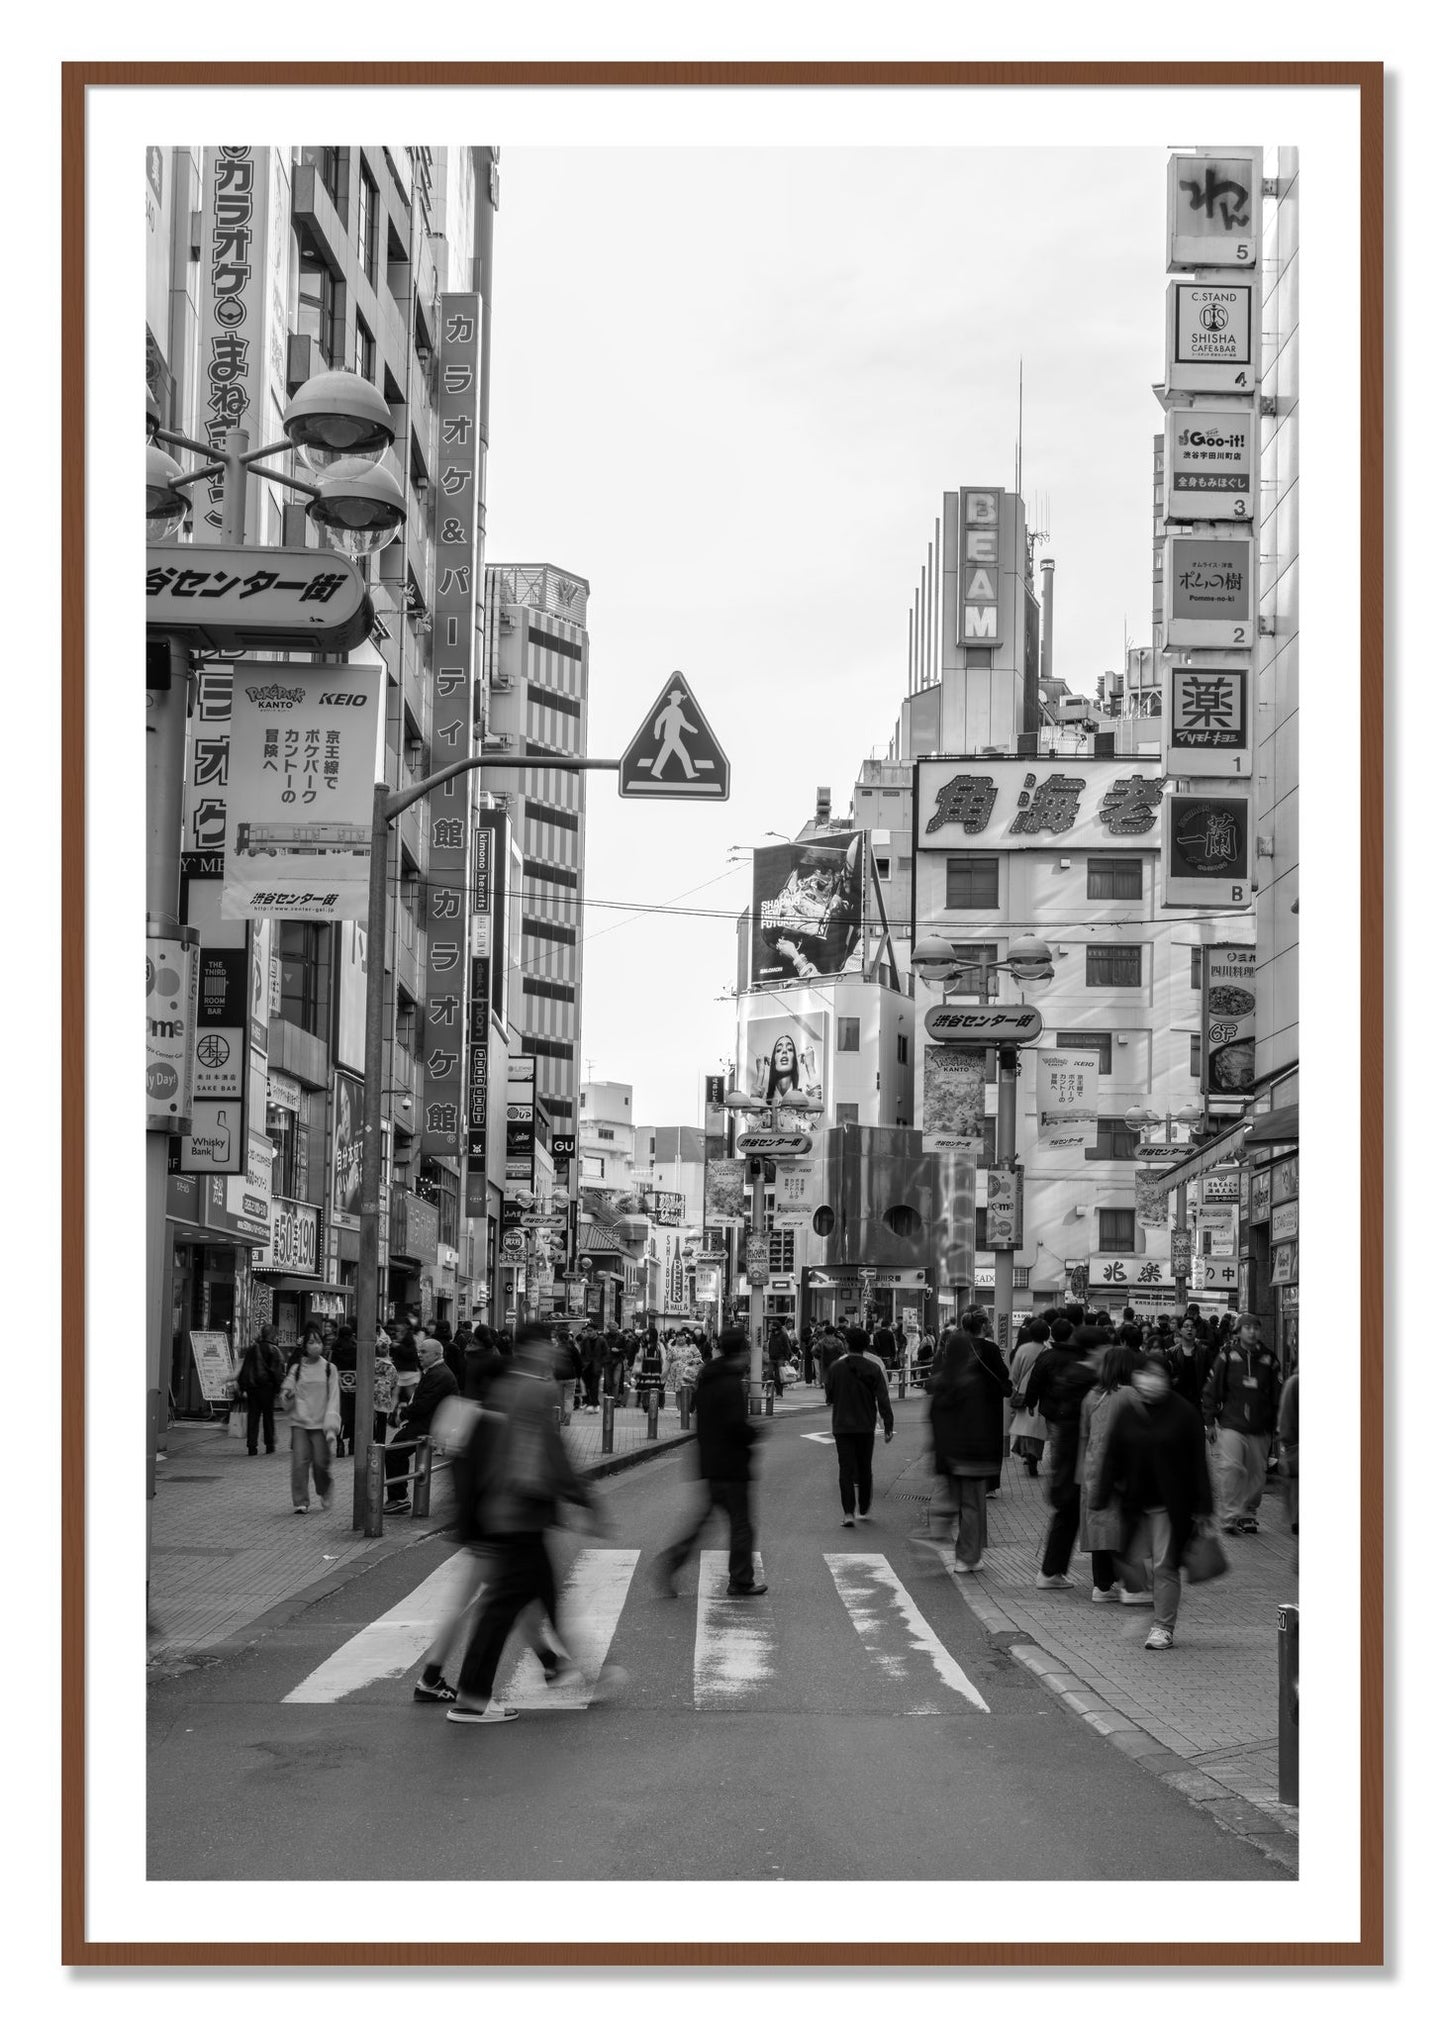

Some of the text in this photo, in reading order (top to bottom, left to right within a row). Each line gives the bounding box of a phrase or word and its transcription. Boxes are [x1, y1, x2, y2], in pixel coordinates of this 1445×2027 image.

[213, 158, 254, 298] カラオケ
[1236, 244, 1249, 260] 5
[1191, 292, 1237, 302] C.STAND
[1191, 333, 1236, 343] SHISHA
[1191, 344, 1236, 352] CAFE&BAR
[1235, 371, 1247, 387] 4
[1178, 476, 1246, 488] 全身もみほぐし
[1234, 499, 1246, 516] 3
[966, 492, 998, 638] BEAM
[1233, 627, 1245, 643] 2
[258, 701, 293, 709] KANTO
[319, 692, 368, 707] KEIO
[1182, 676, 1233, 727] 薬
[1176, 731, 1238, 745] マツモトキヨシ
[262, 728, 279, 772] 冒険へ
[281, 729, 299, 804] カントーの
[302, 729, 320, 804] ポケパーク
[323, 730, 341, 790] 京王線で
[1232, 757, 1241, 772] 1
[925, 772, 1164, 834] 角海老
[478, 834, 486, 869] kimono
[250, 893, 339, 906] 渋谷センター街
[1231, 885, 1243, 901] B
[426, 889, 460, 1135] カラオケ館
[932, 1014, 1036, 1028] 渋谷センター街
[1208, 1023, 1238, 1043] 6F
[156, 1072, 177, 1087] Day!
[192, 1138, 226, 1149] Whisky
[554, 1141, 575, 1151] GU
[741, 1138, 802, 1147] 渋谷センター街
[191, 1147, 212, 1156] Bank
[1103, 1261, 1163, 1282] 兆楽
[673, 1260, 682, 1301] BEER
